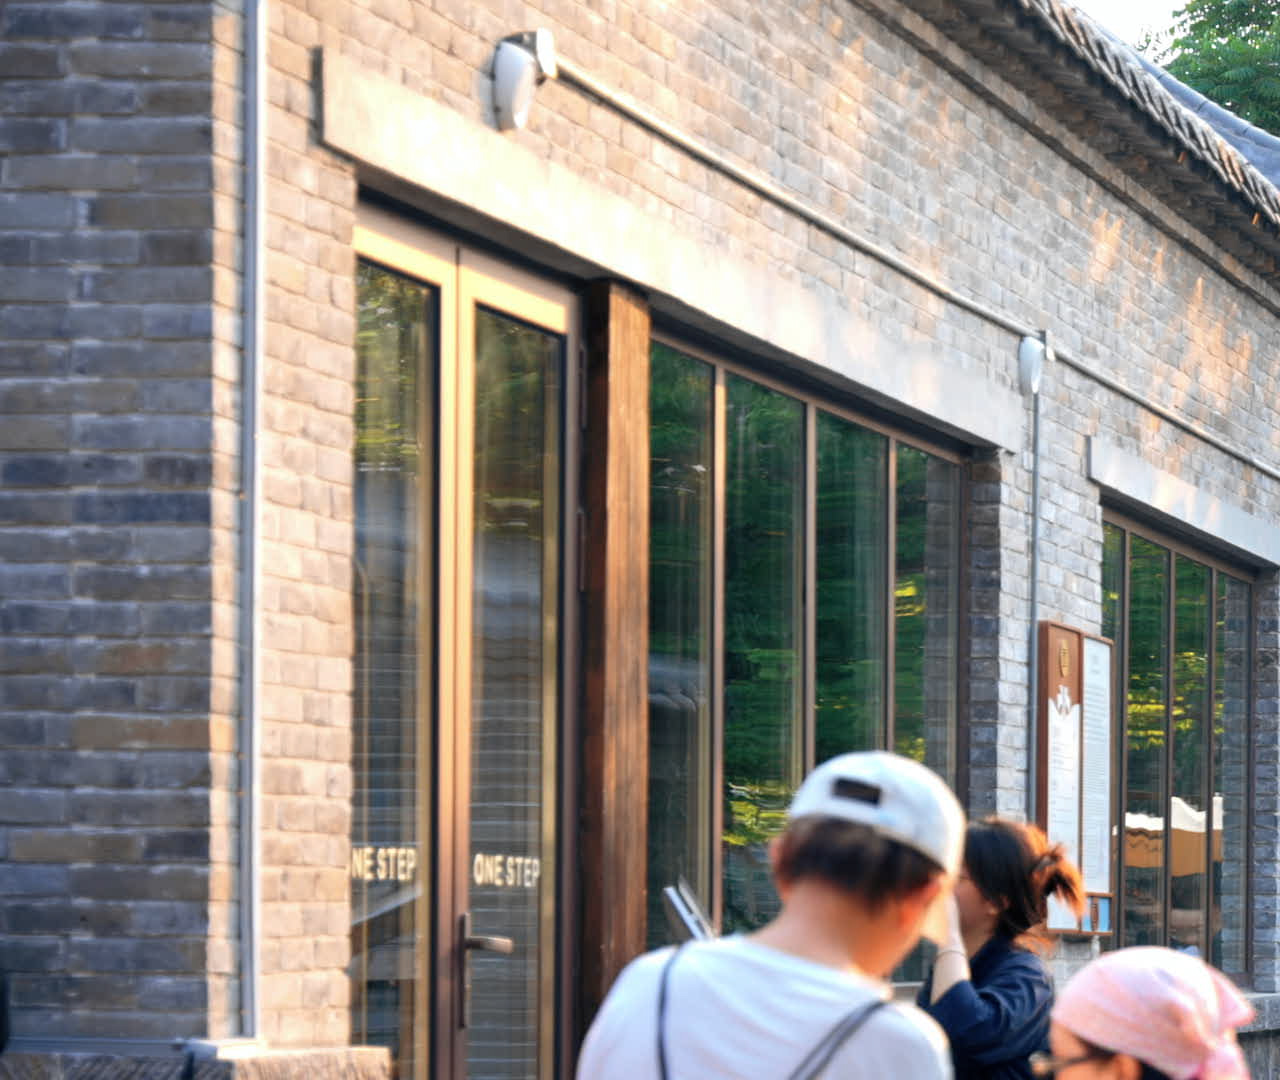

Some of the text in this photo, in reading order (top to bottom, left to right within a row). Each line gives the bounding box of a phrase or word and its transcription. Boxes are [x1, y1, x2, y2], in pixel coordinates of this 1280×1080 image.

[352, 847, 417, 881] NE STEP
[474, 853, 541, 888] ONE STEP
